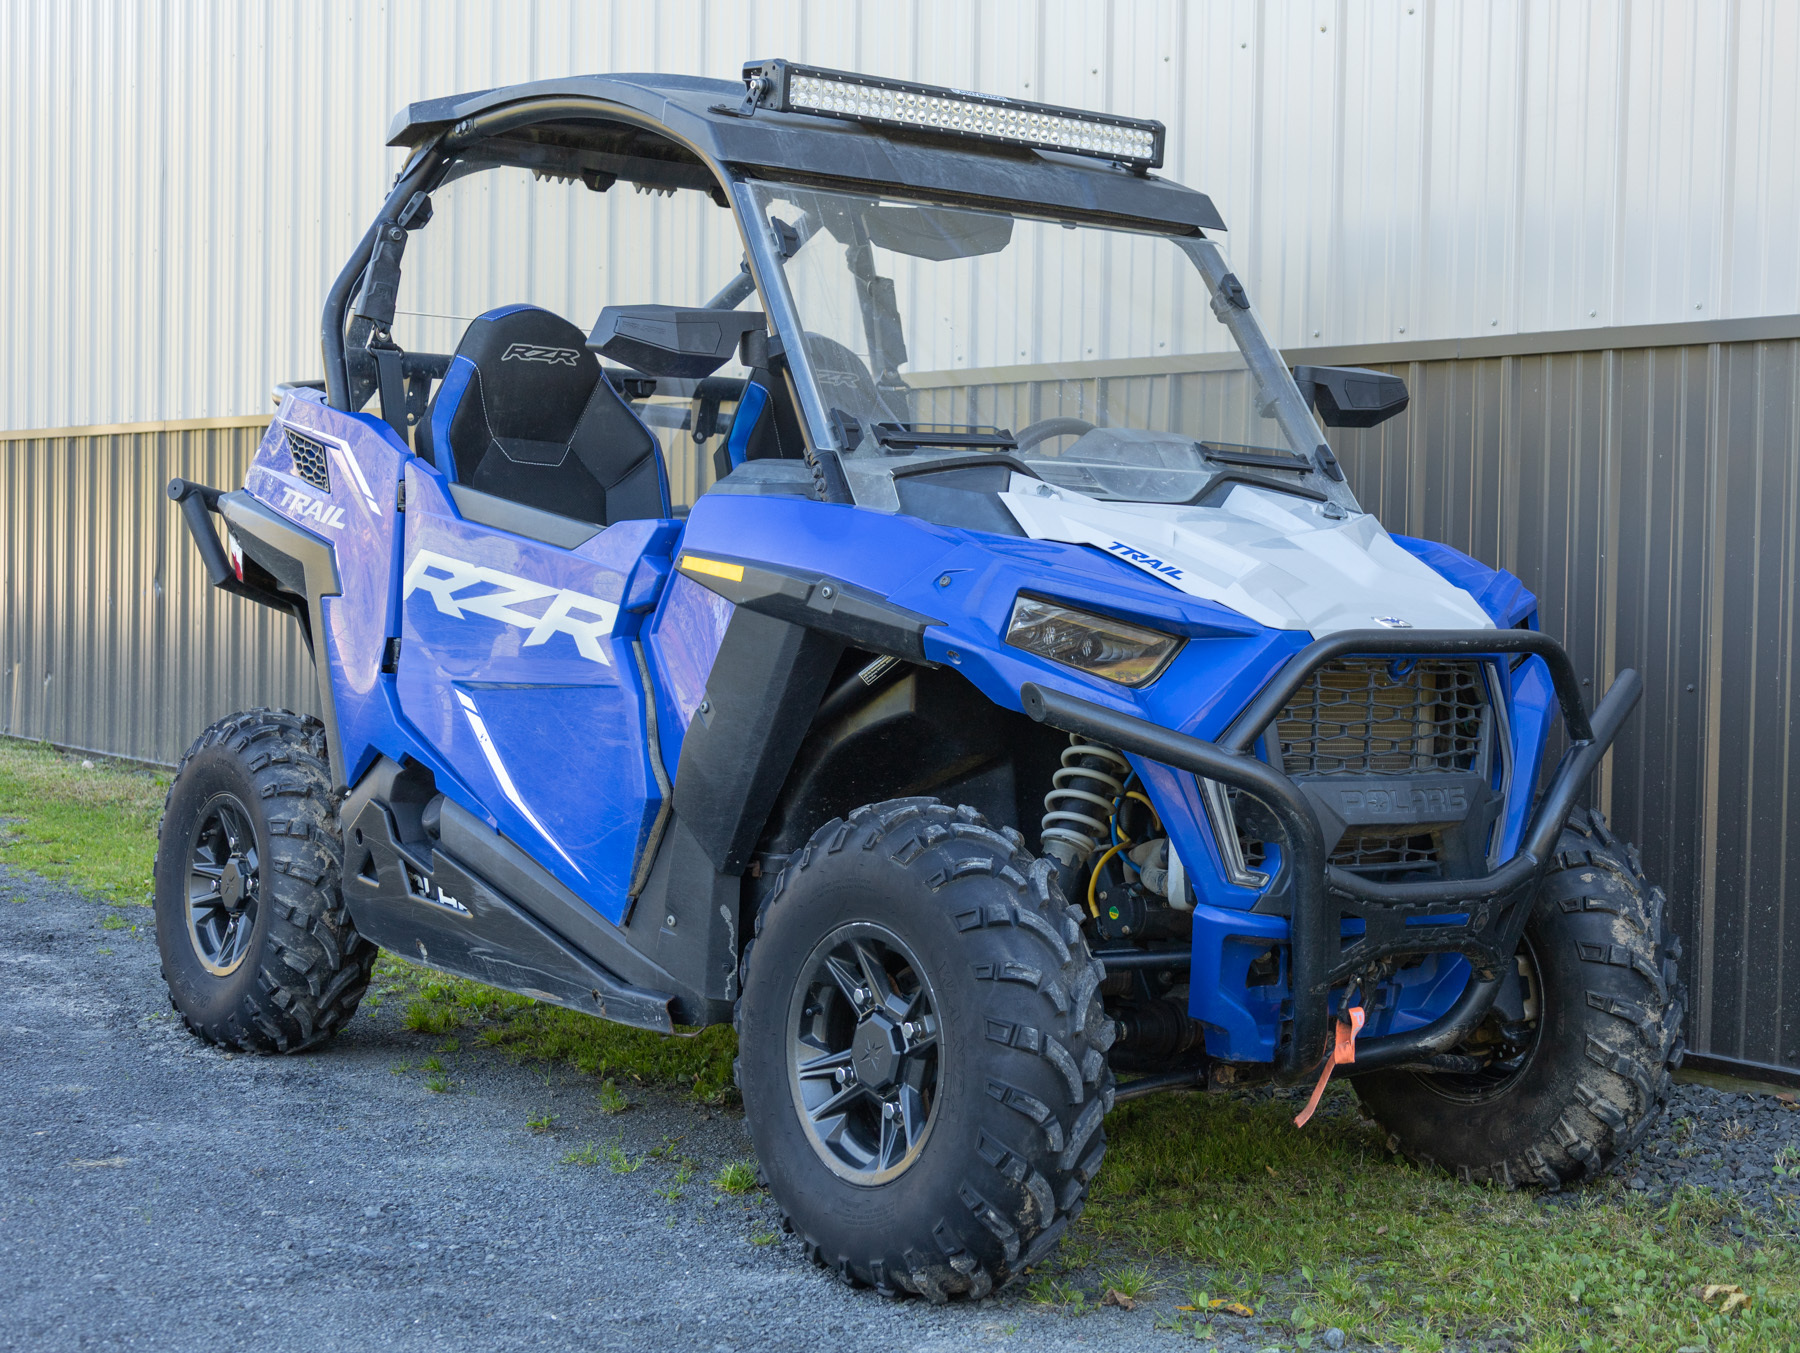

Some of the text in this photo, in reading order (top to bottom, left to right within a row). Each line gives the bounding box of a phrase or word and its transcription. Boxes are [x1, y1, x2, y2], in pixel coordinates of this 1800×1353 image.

[501, 343, 580, 366] RZR
[815, 368, 860, 388] ZR
[280, 486, 346, 530] TRAIL
[1107, 541, 1184, 580] TRAIL
[403, 549, 620, 667] RZR
[1340, 787, 1468, 814] POLARIS
